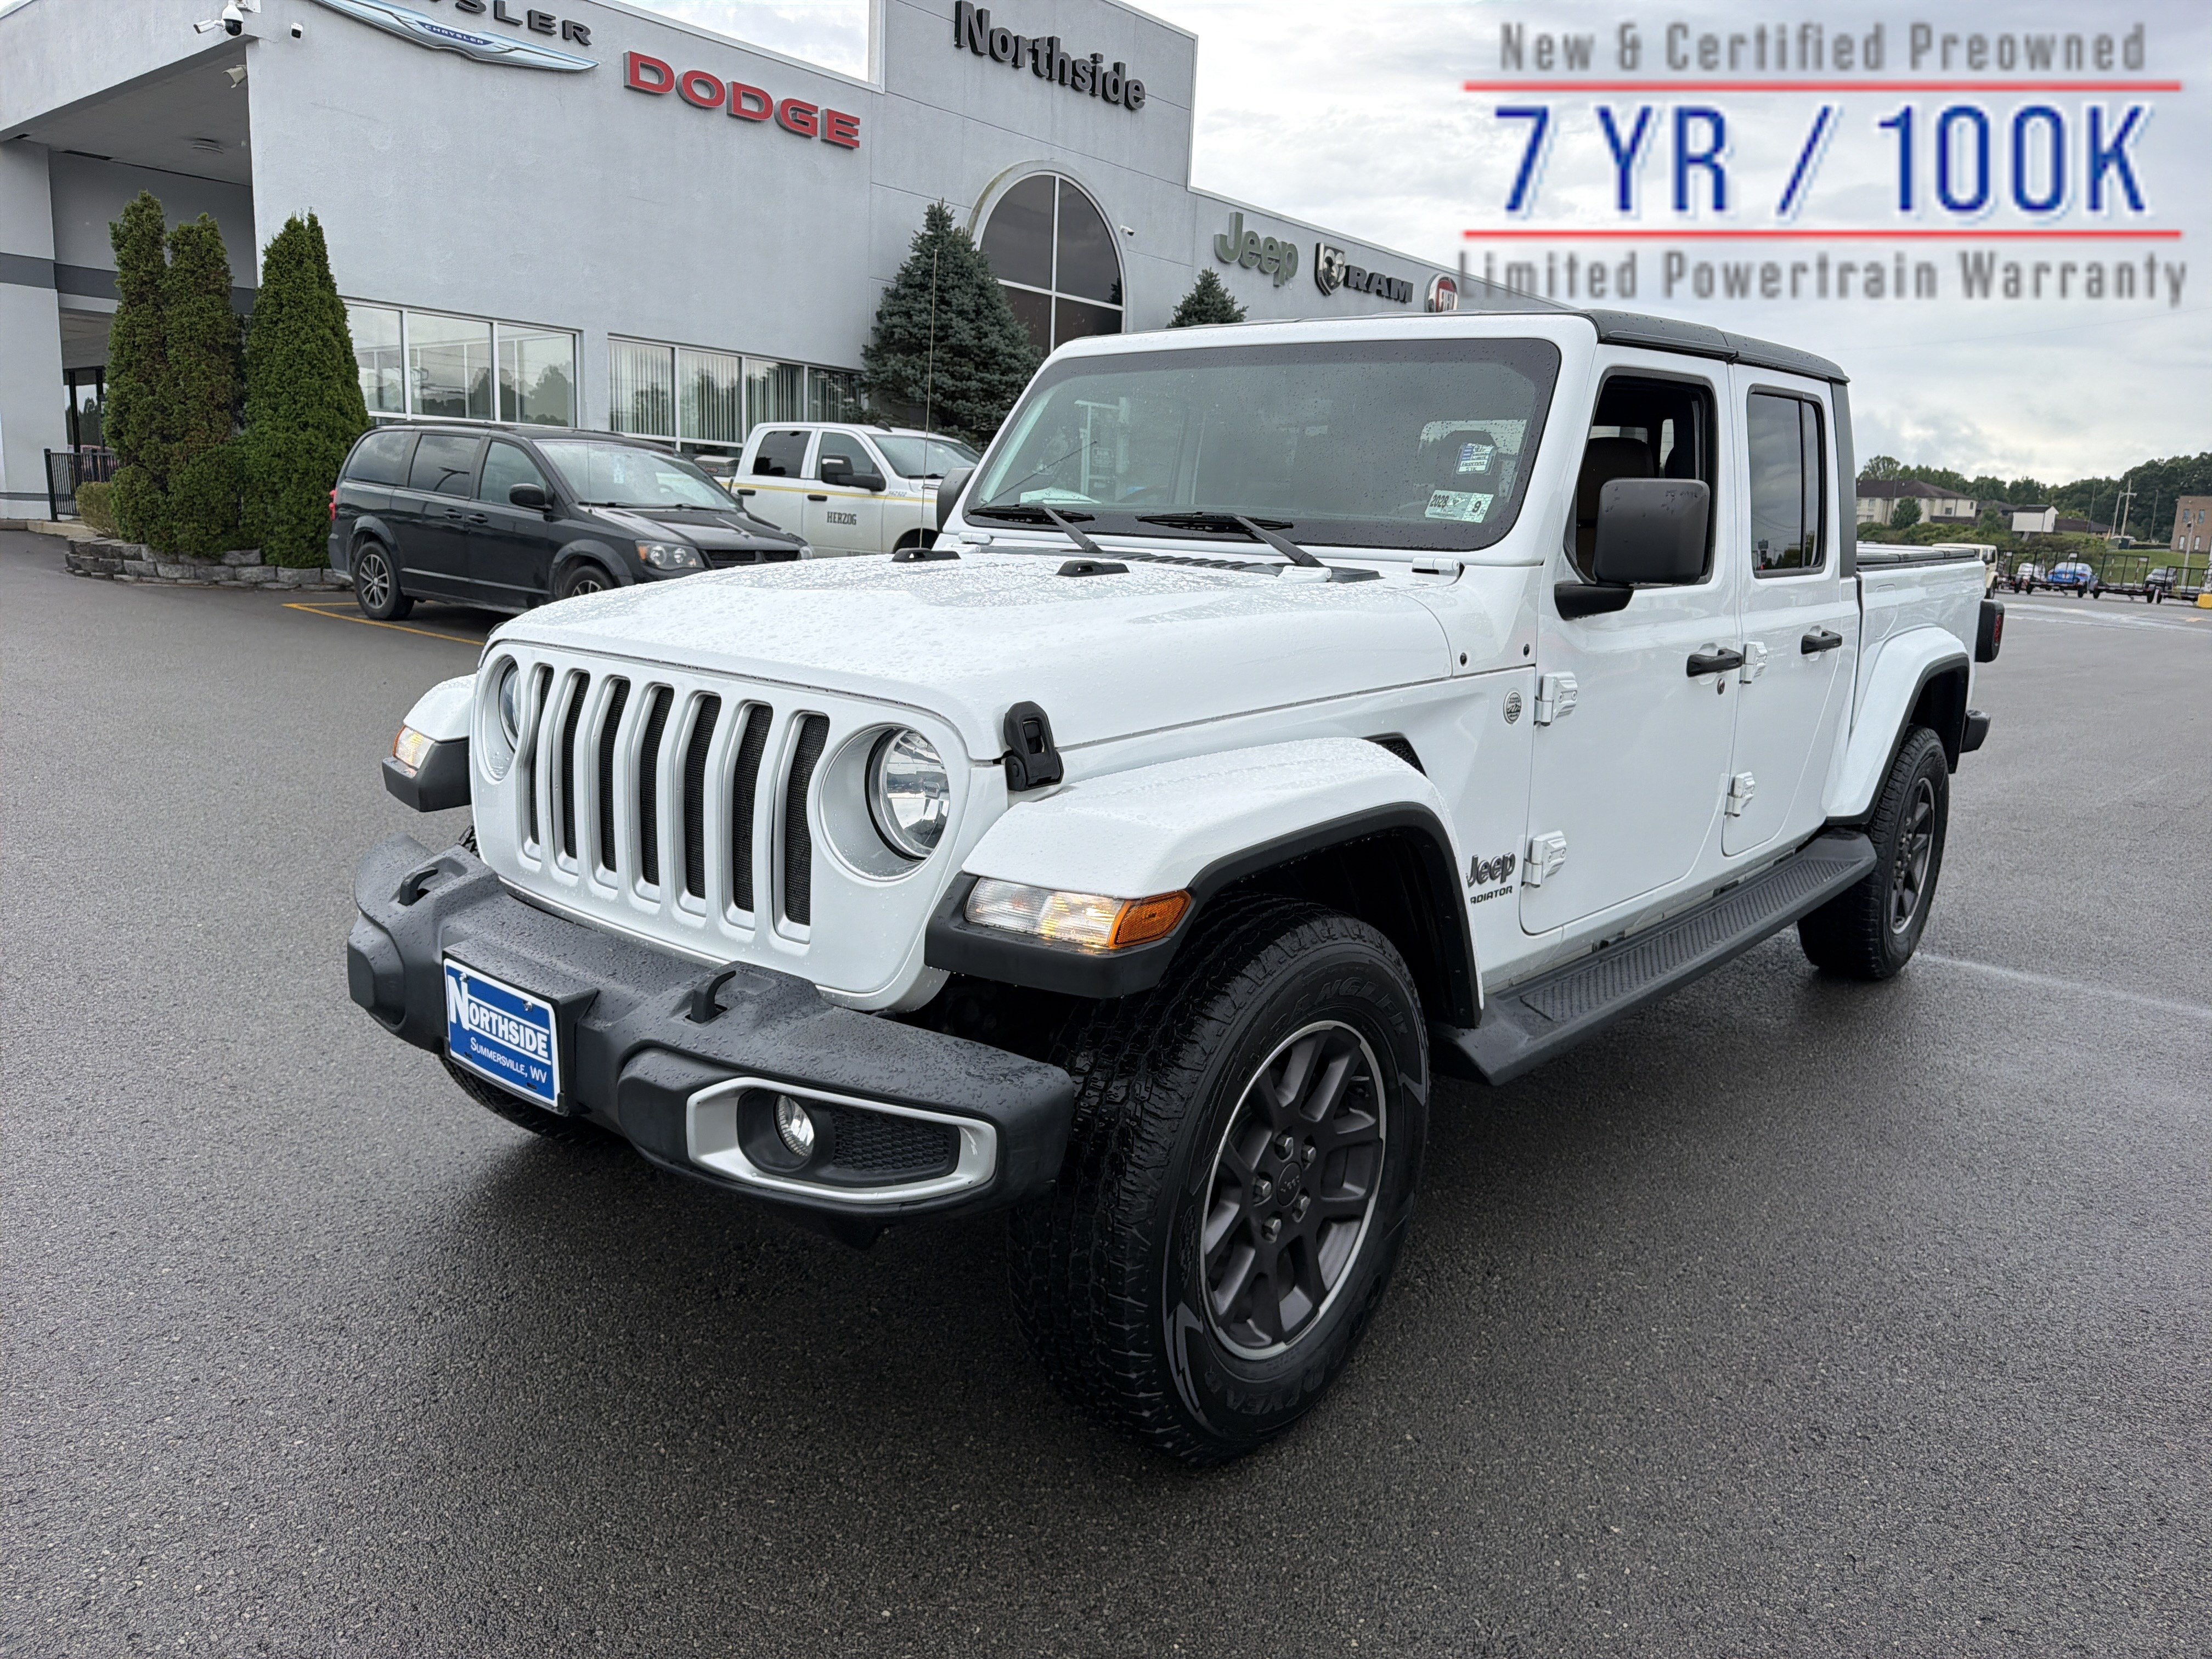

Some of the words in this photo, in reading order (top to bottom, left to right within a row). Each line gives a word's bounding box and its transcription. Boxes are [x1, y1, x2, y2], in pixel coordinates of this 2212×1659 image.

[424, 25, 484, 44] CHRYSLER
[954, 1, 1146, 110] Northside
[623, 50, 860, 149] DODGE
[1214, 212, 1299, 287] Jeep
[1344, 264, 1414, 303] RAM
[826, 511, 857, 525] HERZOG
[1429, 494, 1449, 509] 2028
[1471, 500, 1481, 513] 9
[1465, 851, 1516, 888] Jeep
[448, 975, 548, 1058] NORTHSIDE
[470, 1037, 528, 1078] SUMMERSVILLE,
[530, 1065, 547, 1084] WV
